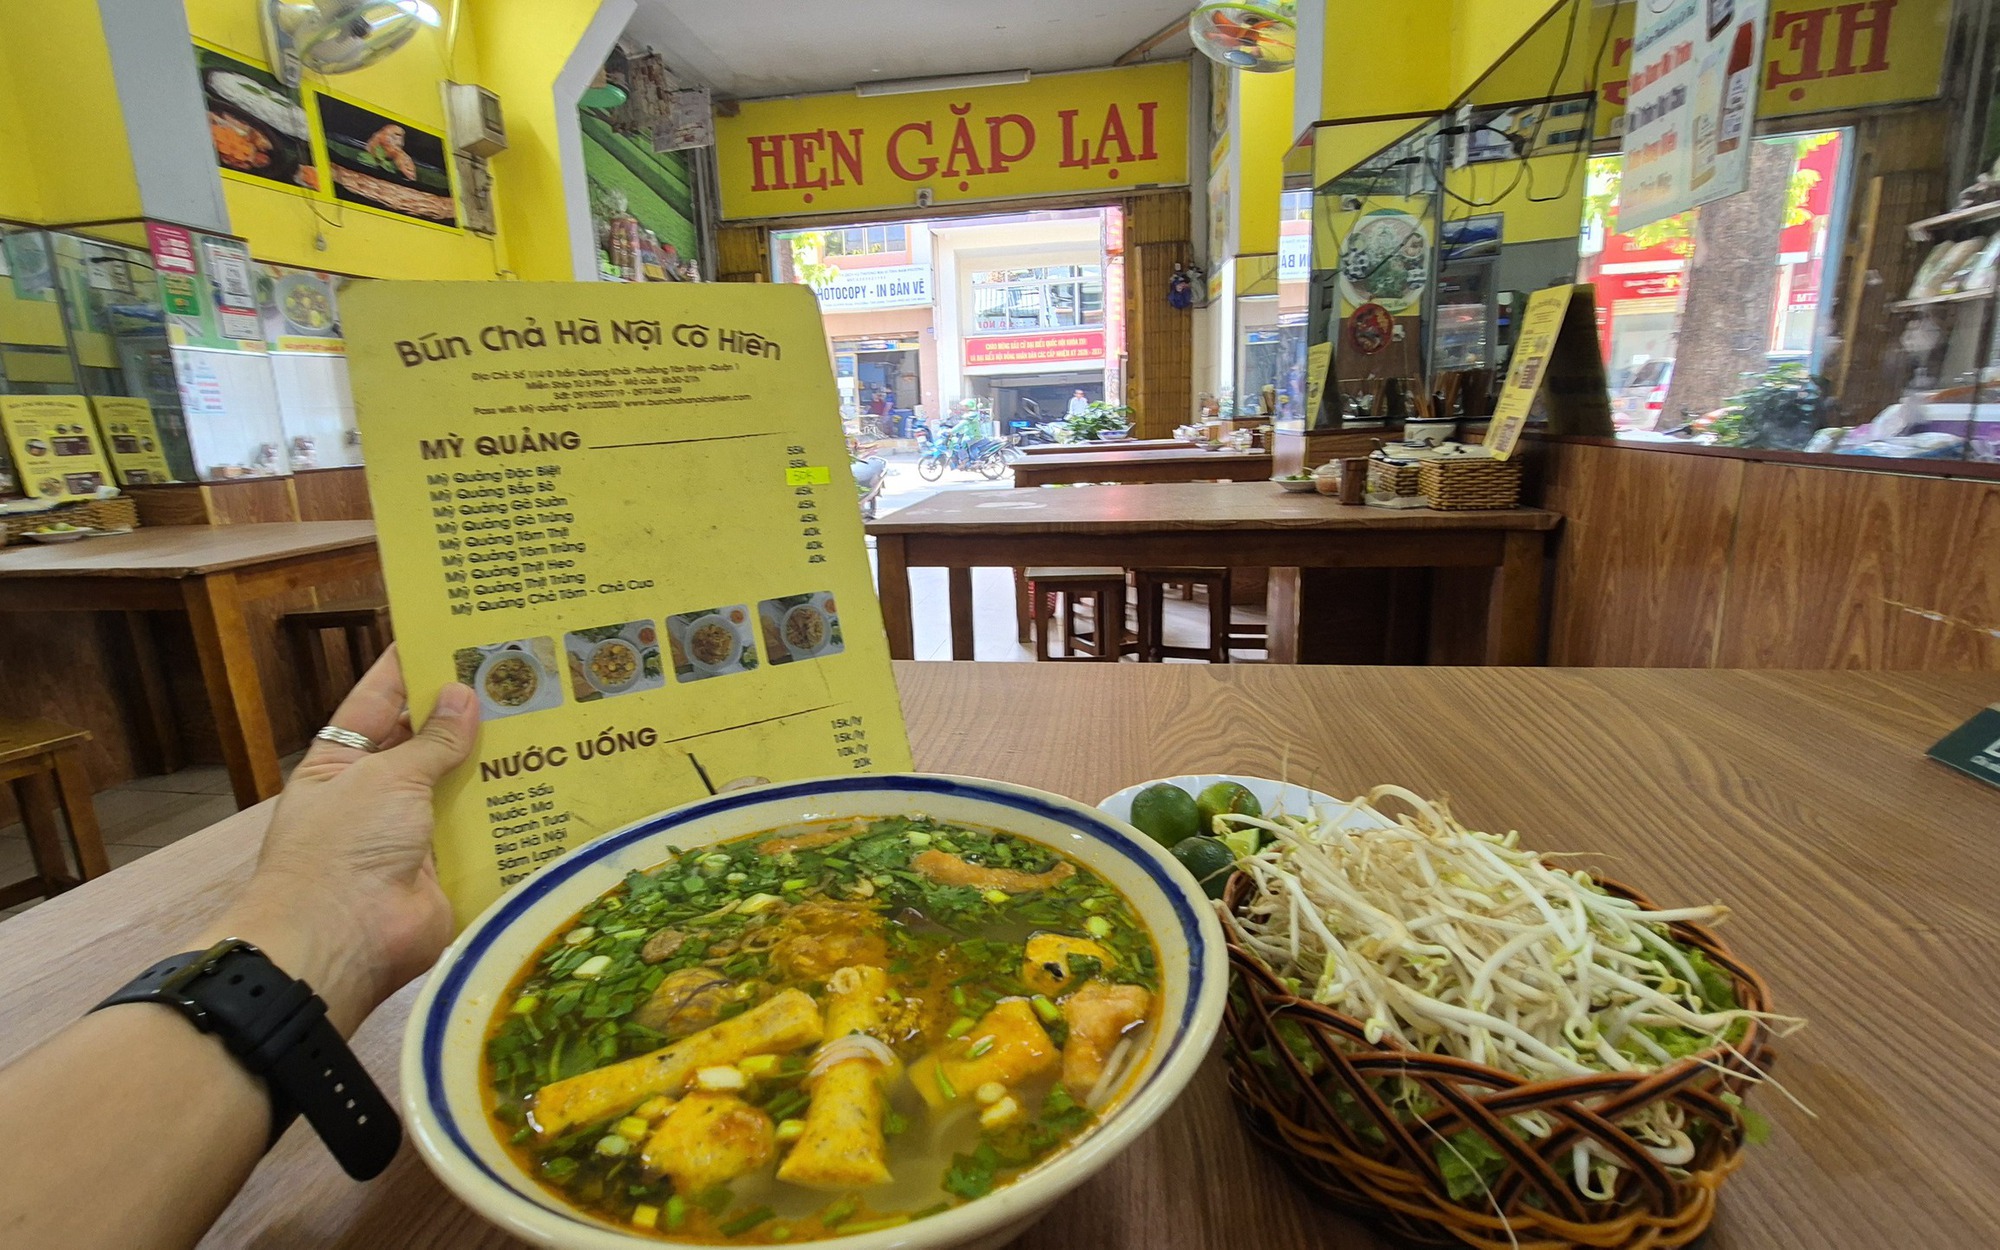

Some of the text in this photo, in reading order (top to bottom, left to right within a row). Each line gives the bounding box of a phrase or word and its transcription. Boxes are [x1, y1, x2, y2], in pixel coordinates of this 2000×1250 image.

[747, 101, 1159, 204] HẸN GẶP LẠI
[816, 285, 867, 301] HOTOCOPY
[876, 284, 887, 297] IN
[890, 278, 910, 297] BẢN
[913, 278, 925, 294] VẼ
[395, 332, 472, 368] Bún
[479, 316, 547, 351] Chả
[555, 318, 602, 346] Hà
[611, 320, 662, 350] Nội
[672, 323, 710, 348] Cô
[419, 426, 582, 460] MỲ QUẢNG
[480, 726, 658, 782] NƯỚC UỐNG
